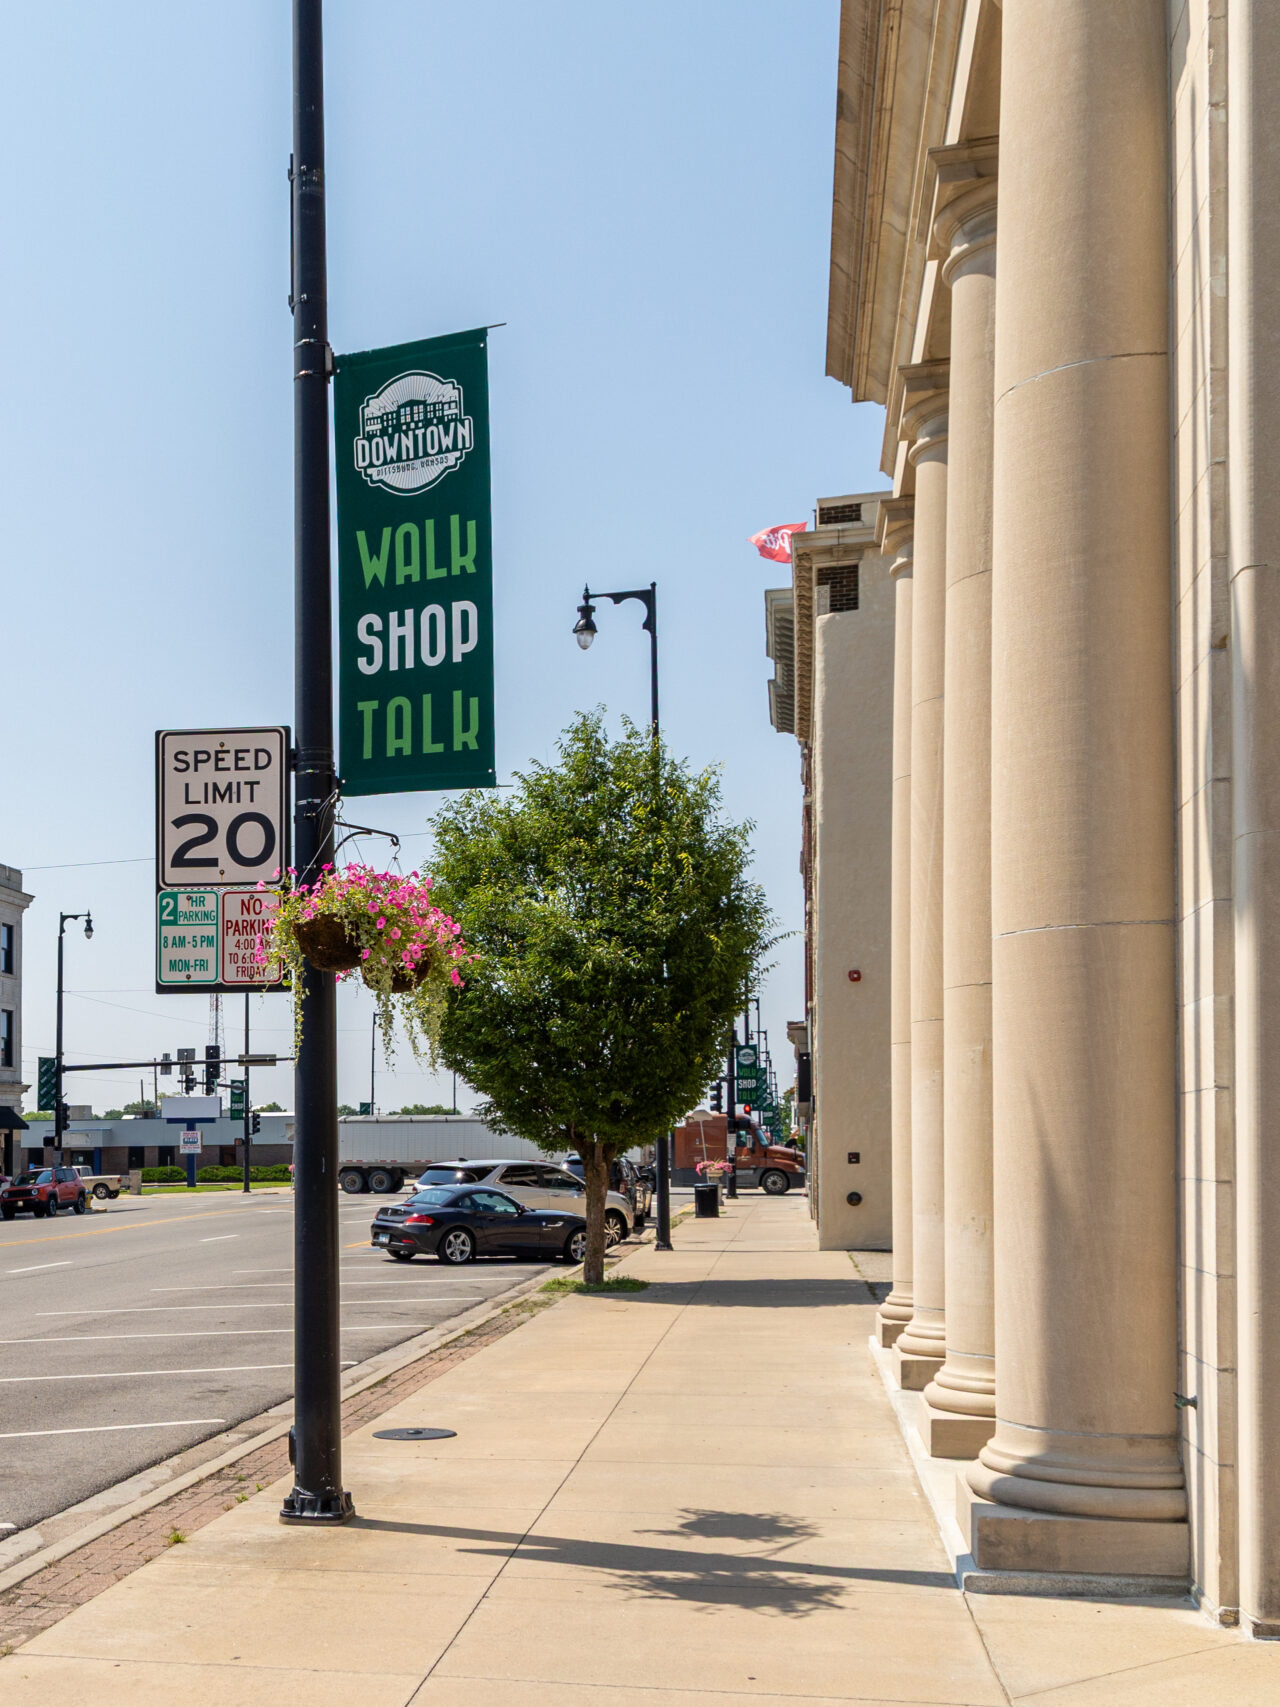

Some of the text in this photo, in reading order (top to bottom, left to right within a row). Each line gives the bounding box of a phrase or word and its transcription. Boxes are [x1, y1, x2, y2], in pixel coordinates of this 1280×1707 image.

[357, 419, 470, 468] DOWNTOWN
[420, 455, 449, 468] KANSAS
[355, 514, 477, 591] WALK
[357, 600, 478, 675] SHOP
[357, 689, 479, 760] TALK
[173, 748, 272, 773] SPEED
[184, 780, 261, 805] LIMIT
[170, 811, 276, 868] 20
[161, 897, 175, 920] 2
[190, 895, 206, 908] HR
[241, 898, 263, 916] NO
[178, 910, 216, 922] PARKING
[163, 936, 169, 949] 8
[171, 936, 186, 948] AM
[192, 936, 198, 948] 5
[200, 935, 215, 948] PM
[235, 938, 255, 950] 4:00
[169, 959, 209, 972] MON-FRI
[228, 952, 260, 965] TO 6:0
[236, 966, 267, 978] FRIDAY
[738, 1079, 757, 1089] SHOP
